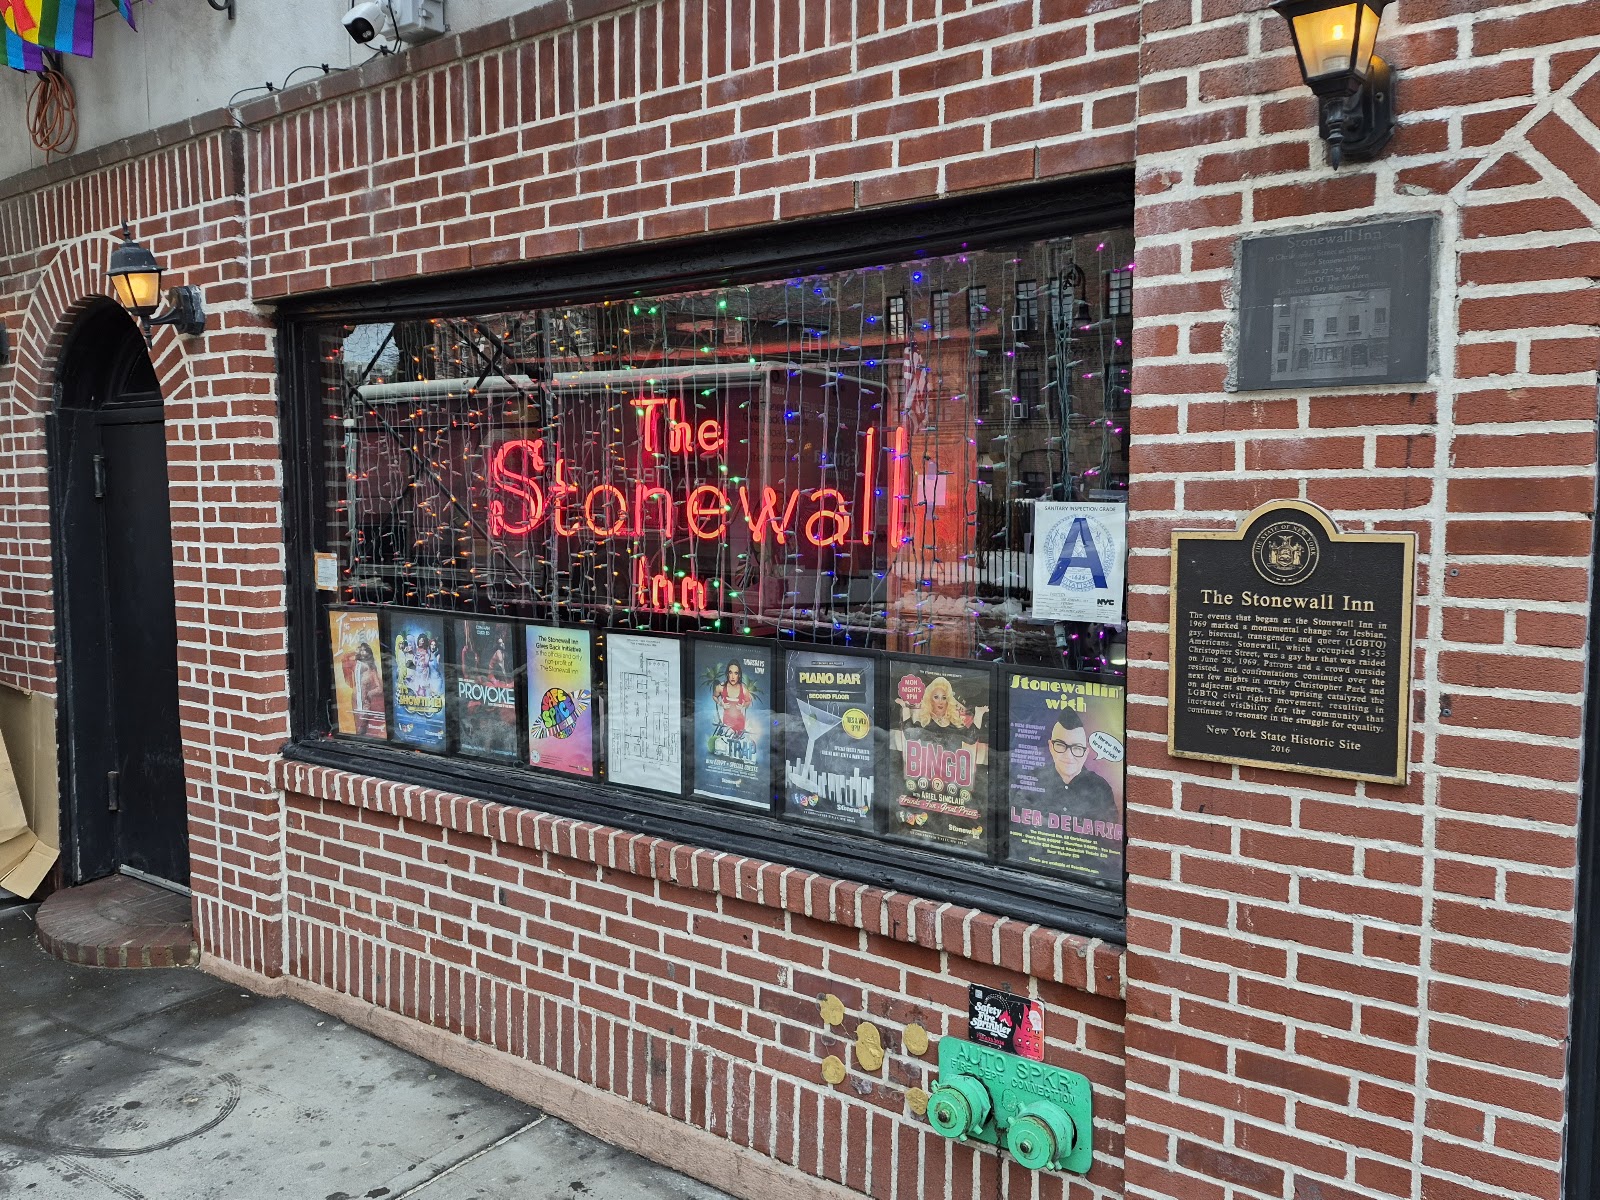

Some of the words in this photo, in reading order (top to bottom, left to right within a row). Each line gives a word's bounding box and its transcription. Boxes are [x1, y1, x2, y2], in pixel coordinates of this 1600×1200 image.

[1288, 230, 1352, 249] Stonewall
[1358, 228, 1381, 241] Inn
[630, 398, 724, 452] The
[491, 427, 905, 550] Stonewall
[1261, 526, 1278, 540] STATE
[1293, 526, 1307, 536] NEW
[1307, 537, 1316, 556] YORK
[1047, 518, 1108, 589] A
[638, 556, 706, 610] Inn
[1201, 590, 1233, 606] The
[1242, 592, 1334, 610] Stonewall
[1343, 596, 1375, 612] Inn
[1207, 612, 1231, 620] events
[1255, 615, 1278, 624] began
[1312, 618, 1353, 627] Stonewall
[1358, 620, 1372, 628] Inn
[1378, 621, 1386, 629] in
[1210, 621, 1238, 629] marked
[1251, 624, 1298, 633] monumental
[1303, 627, 1331, 637] change
[1336, 628, 1348, 636] for
[548, 636, 570, 644] Stonewall
[1188, 637, 1231, 646] Americans.
[1237, 640, 1280, 651] Stonewall,
[1285, 643, 1310, 652] which
[1316, 645, 1354, 656] occupied
[1247, 632, 1293, 643] transgender
[1297, 635, 1312, 643] and
[1317, 638, 1340, 646] queer
[1345, 638, 1385, 649] (LGBTQ)
[1188, 646, 1232, 657] Christopher
[1234, 649, 1259, 659] Street,
[1288, 654, 1302, 662] gay
[1358, 657, 1385, 666] raided
[1201, 655, 1218, 663] June
[1263, 660, 1292, 668] Patrons
[1296, 662, 1311, 670] and
[1324, 664, 1350, 672] crowd
[1354, 666, 1385, 675] outside
[548, 666, 570, 674] Stonewall
[799, 672, 834, 684] PIANO
[836, 673, 860, 685] BAR
[1241, 667, 1298, 678] confrontations
[1302, 671, 1342, 681] continued
[458, 682, 515, 704] PROVOKE
[902, 686, 922, 694] NIGHTS
[1010, 675, 1122, 698] Stonewallin'
[1200, 682, 1231, 692] adjacent
[1236, 684, 1263, 693] streets.
[1268, 687, 1285, 695] This
[1289, 689, 1322, 700] uprising
[1327, 692, 1366, 703] catalyzed
[1371, 695, 1384, 703] the
[1207, 673, 1221, 681] few
[1224, 675, 1248, 684] nights
[1263, 678, 1290, 688] nearby
[1294, 680, 1342, 692] Christopher
[1346, 684, 1365, 692] Park
[1369, 686, 1384, 694] and
[542, 689, 566, 710] SAFE
[1046, 694, 1087, 712] with
[1187, 689, 1217, 699] LGBTQ
[1223, 692, 1241, 700] civil
[1247, 694, 1271, 704] rights
[1329, 701, 1369, 712] resulting
[1187, 698, 1224, 707] increased
[1230, 701, 1268, 713] visibility
[1274, 705, 1286, 713] for
[1311, 708, 1360, 721] community
[1366, 713, 1383, 721] that
[1187, 707, 1222, 716] continues
[1235, 711, 1267, 720] resonate
[1280, 715, 1293, 723] the
[1295, 716, 1328, 728] struggle
[1346, 721, 1383, 733] equality.
[1206, 725, 1229, 736] New
[1233, 727, 1256, 739] York
[1260, 730, 1286, 743] State
[1291, 734, 1334, 748] Historic
[1340, 740, 1361, 750] Site
[726, 739, 757, 760] TRAP
[1103, 748, 1118, 760] brick!
[1271, 745, 1290, 754] 2016
[906, 740, 972, 786] BINGO
[922, 791, 938, 801] ARIEL
[938, 794, 964, 806] SINCLAIR
[940, 802, 956, 812] Great
[958, 806, 978, 817] Prizes
[1011, 806, 1042, 826] LEA
[975, 1002, 1002, 1018] Safety
[978, 1011, 996, 1022] Fire
[970, 1018, 1012, 1034] Sprinkler
[957, 1043, 1006, 1072] AUTO
[1016, 1060, 1072, 1093] SPKR
[950, 1058, 972, 1073] FIRE
[978, 1067, 1004, 1084] DEPT.
[1011, 1078, 1076, 1106] CONNECTION
